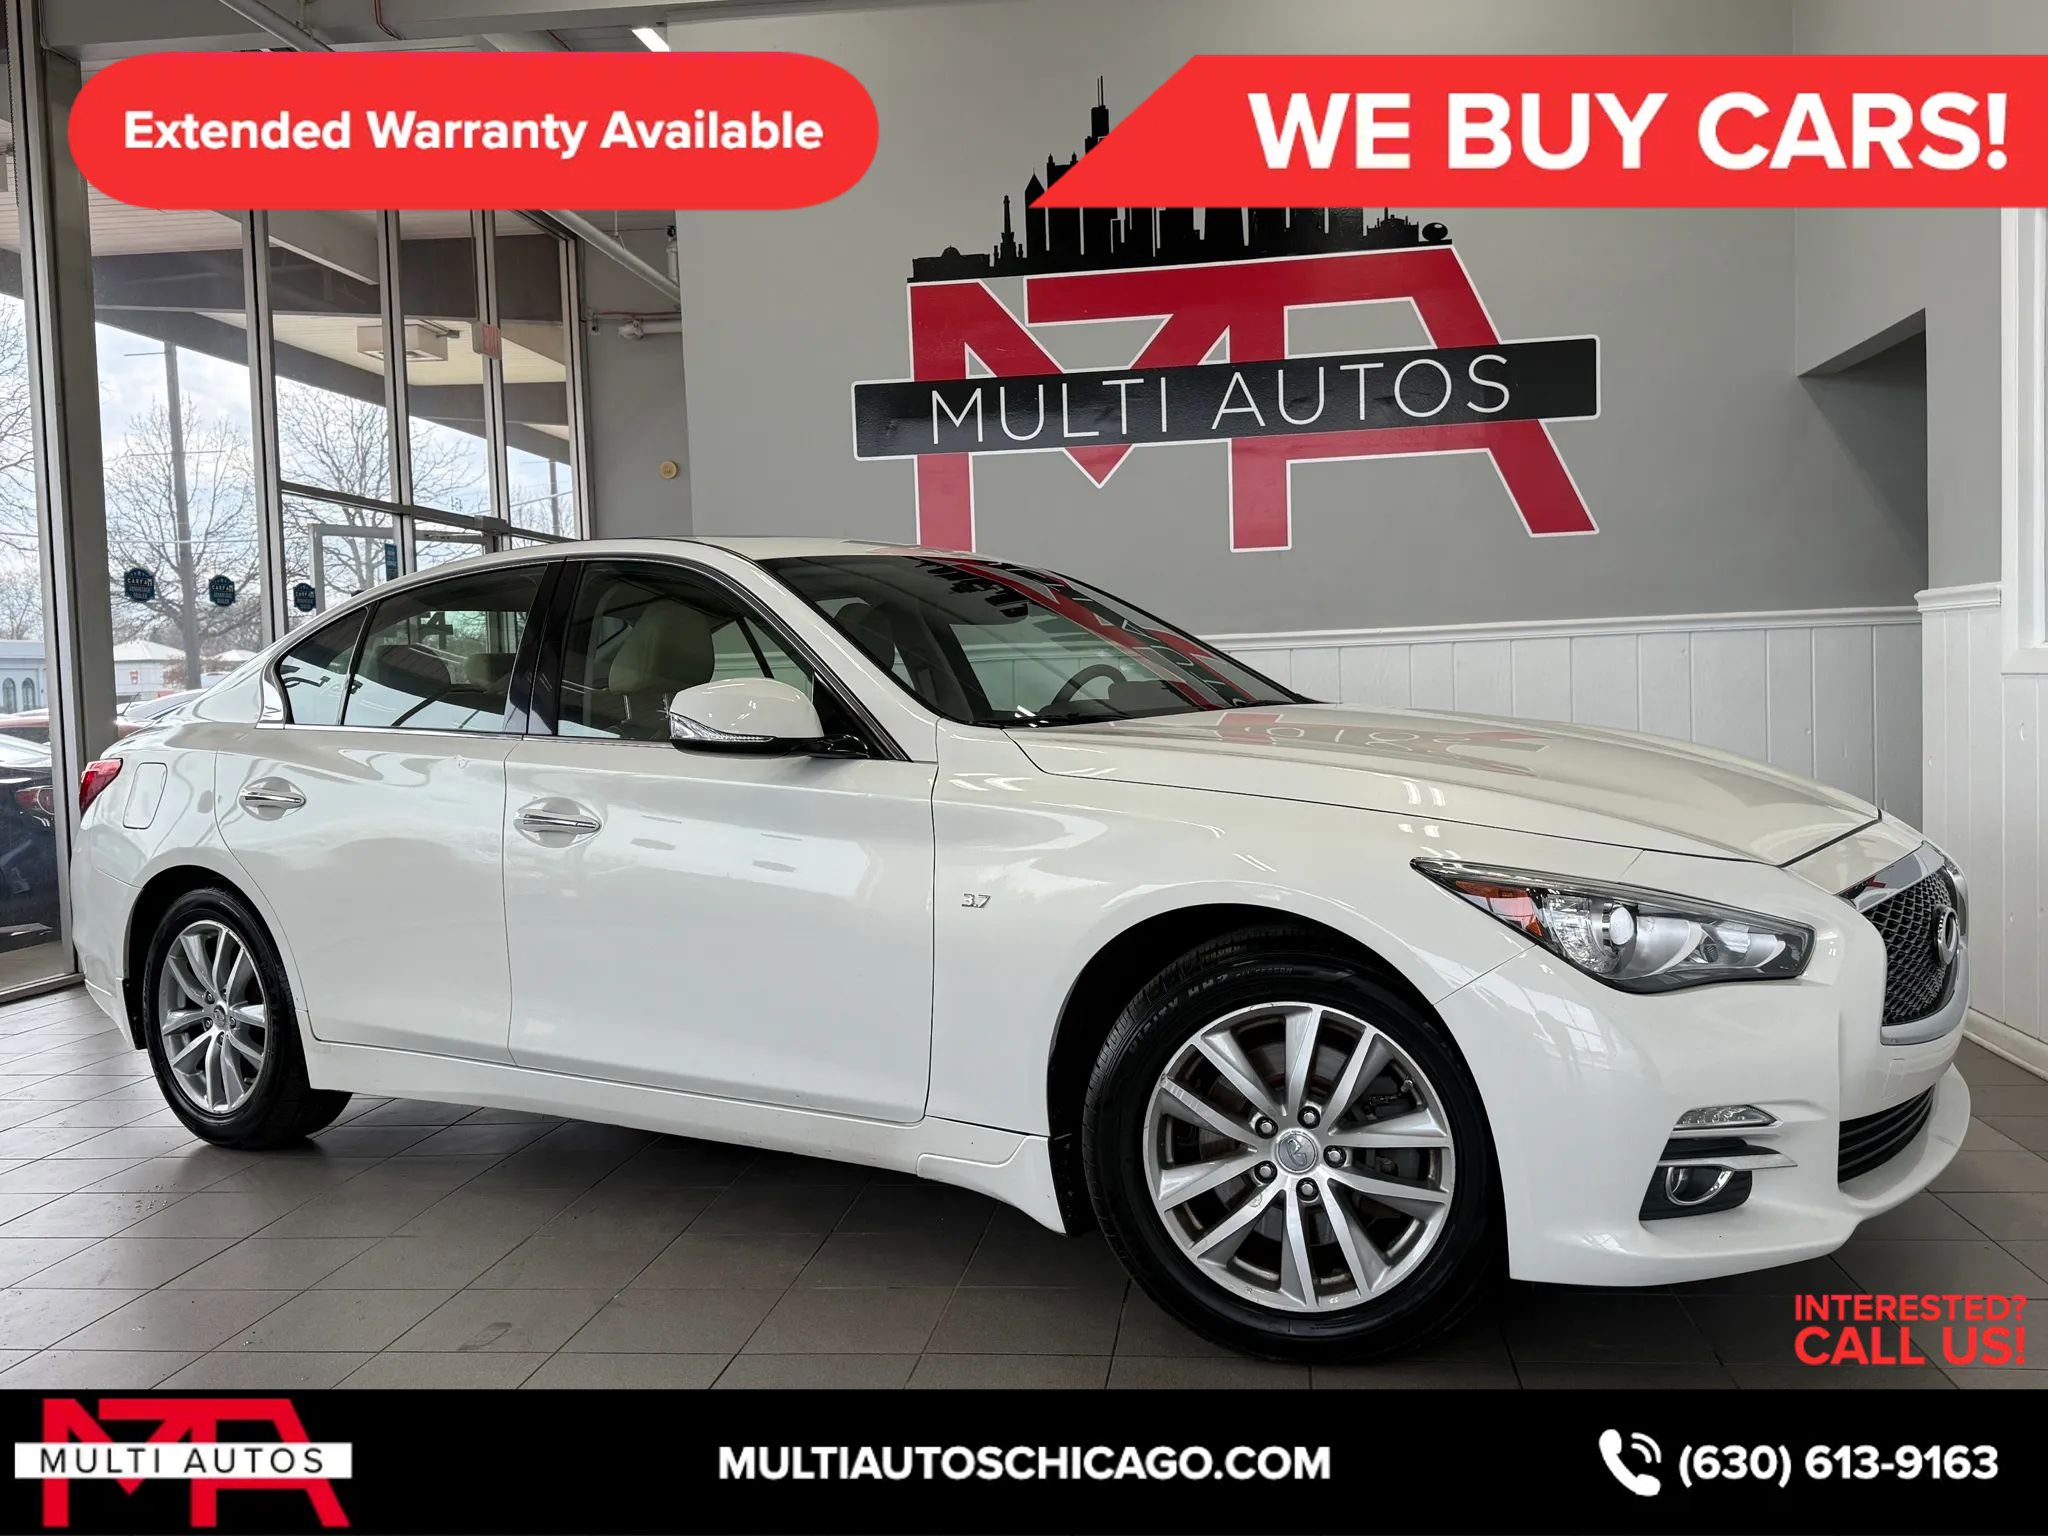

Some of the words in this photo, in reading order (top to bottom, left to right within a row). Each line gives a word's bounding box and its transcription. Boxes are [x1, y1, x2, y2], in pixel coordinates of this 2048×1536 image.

[930, 377, 1169, 445] MULTI
[1211, 354, 1510, 431] AUTOS
[961, 892, 991, 909] 3.7
